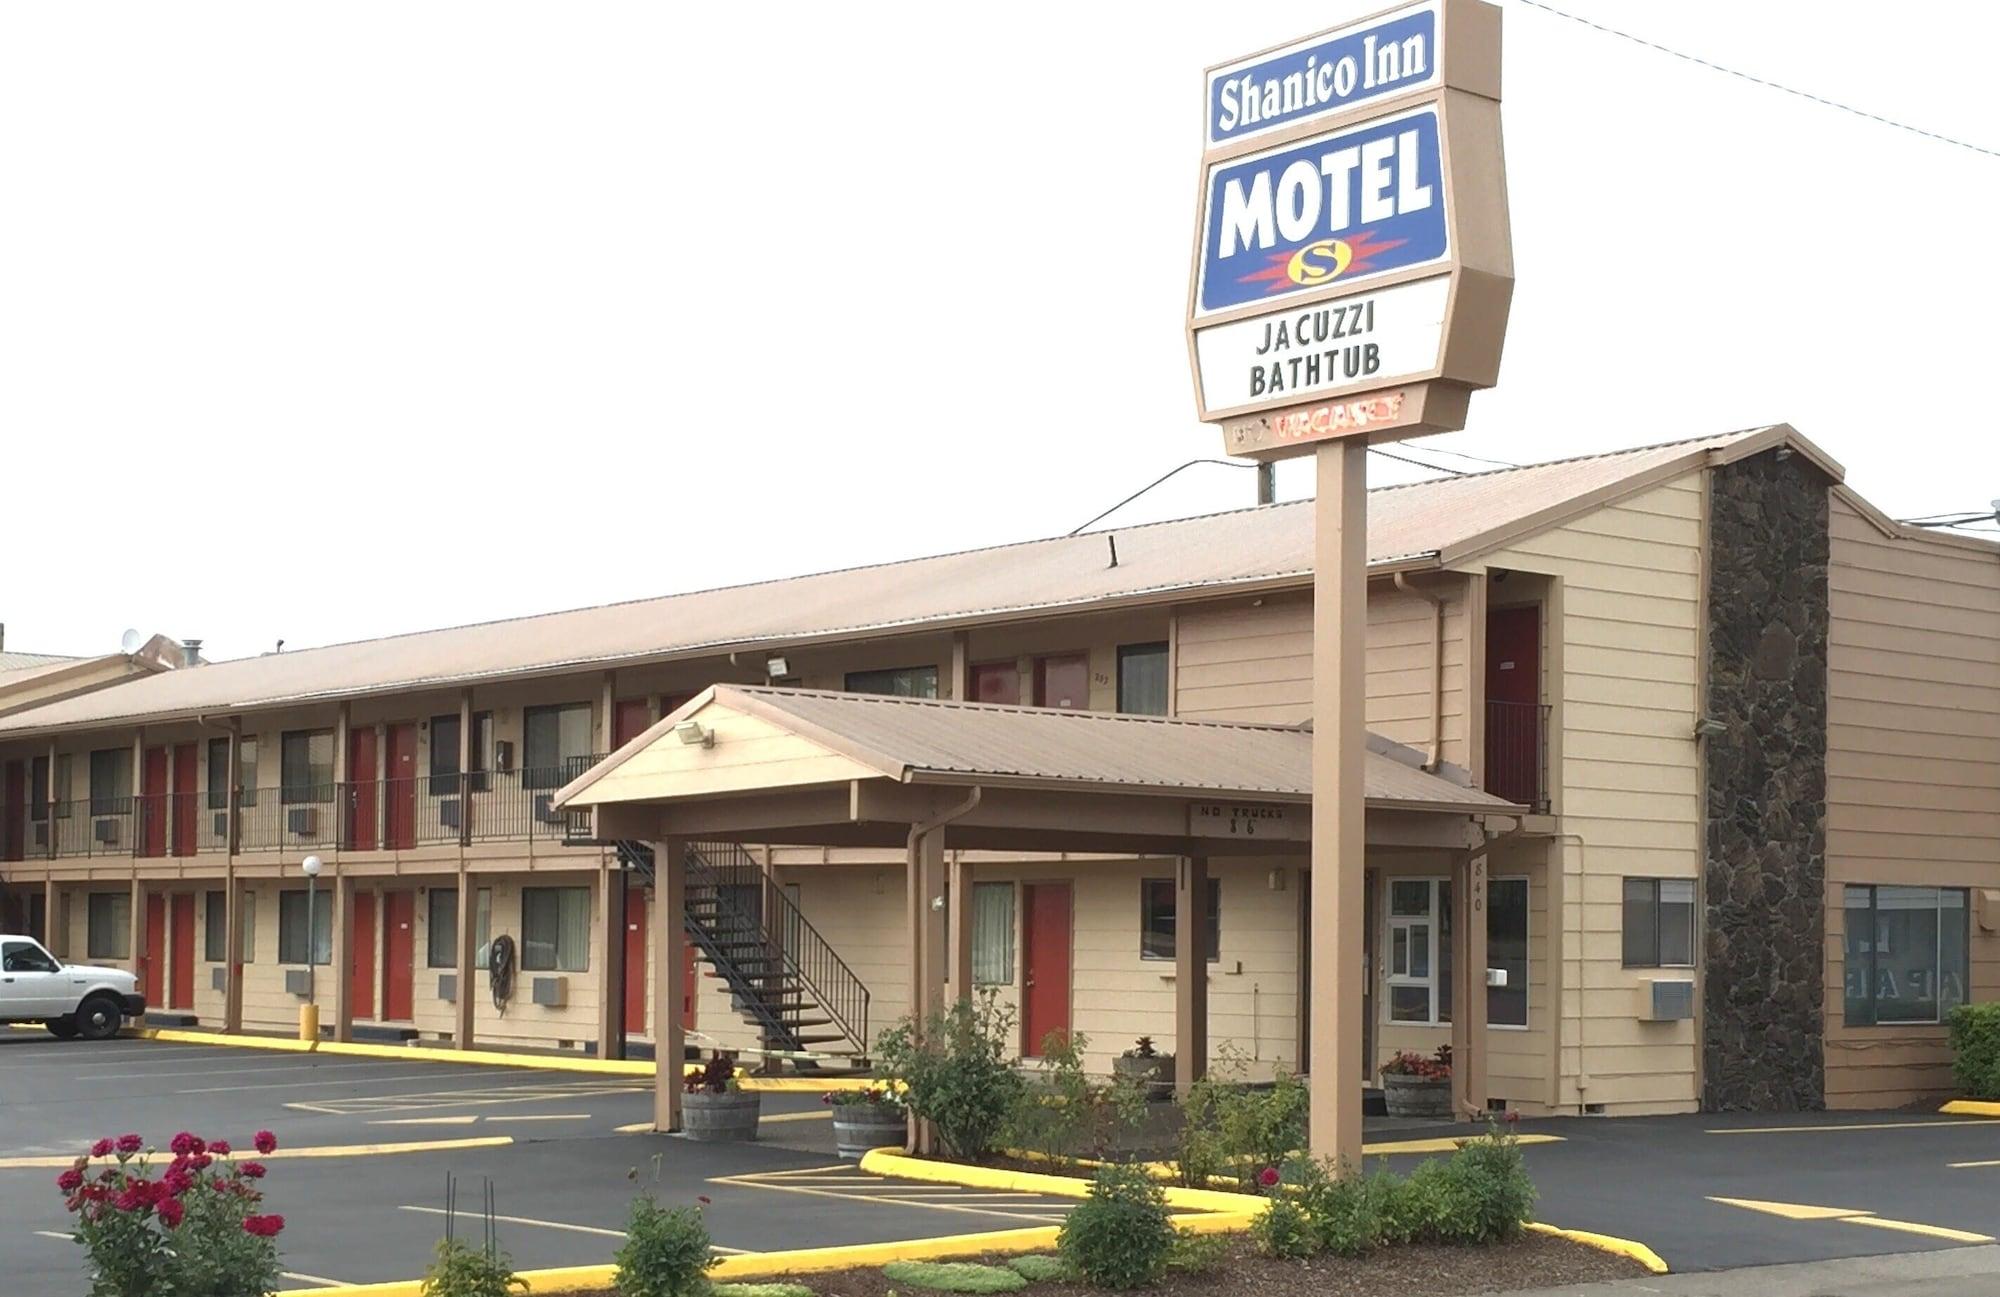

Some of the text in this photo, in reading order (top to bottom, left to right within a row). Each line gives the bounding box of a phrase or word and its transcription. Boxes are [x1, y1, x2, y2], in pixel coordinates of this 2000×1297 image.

[1219, 33, 1428, 132] Shanico Inn
[1218, 128, 1433, 259] MOTEL
[1301, 242, 1339, 282] S
[1255, 300, 1375, 355] JACUZZI
[1250, 343, 1380, 397] BATHTUB
[1200, 806, 1283, 820] NO TRUCKS
